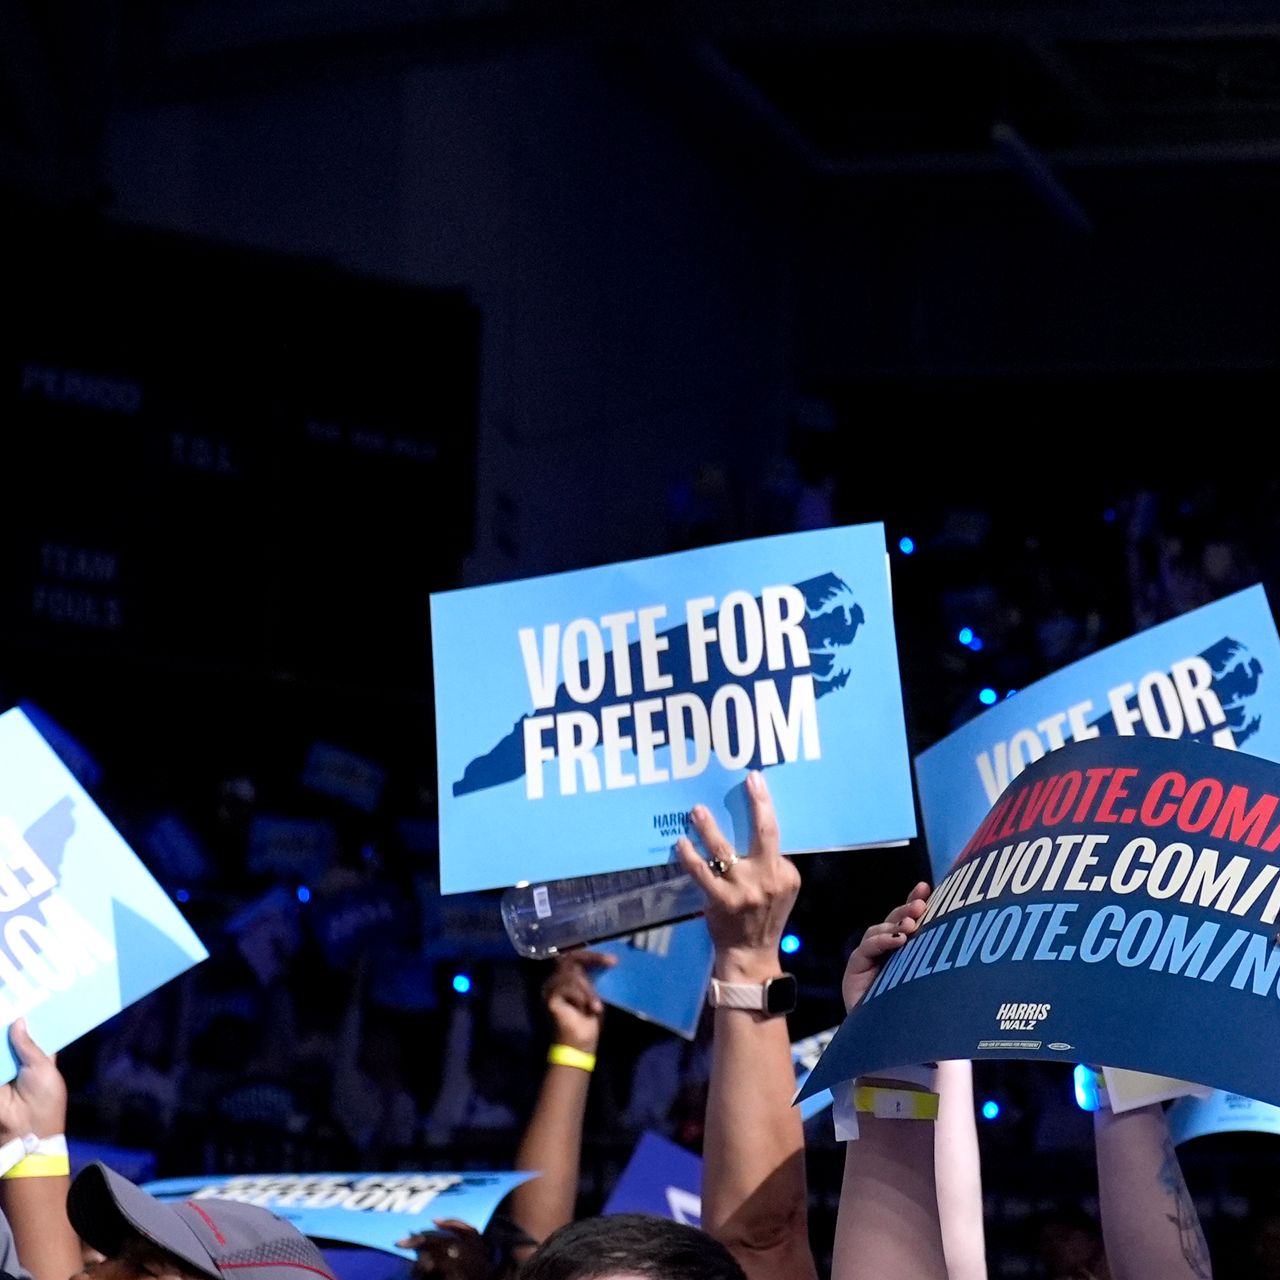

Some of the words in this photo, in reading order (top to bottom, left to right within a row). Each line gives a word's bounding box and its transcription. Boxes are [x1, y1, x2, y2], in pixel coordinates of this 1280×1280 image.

[518, 605, 673, 710] VOTE
[686, 584, 811, 683] FOR
[523, 675, 822, 800] FREEDOM
[976, 700, 1099, 806] VOTE
[1108, 656, 1225, 739] FOR
[996, 1003, 1051, 1020] HARRIS
[1000, 1020, 1037, 1030] WALZ
